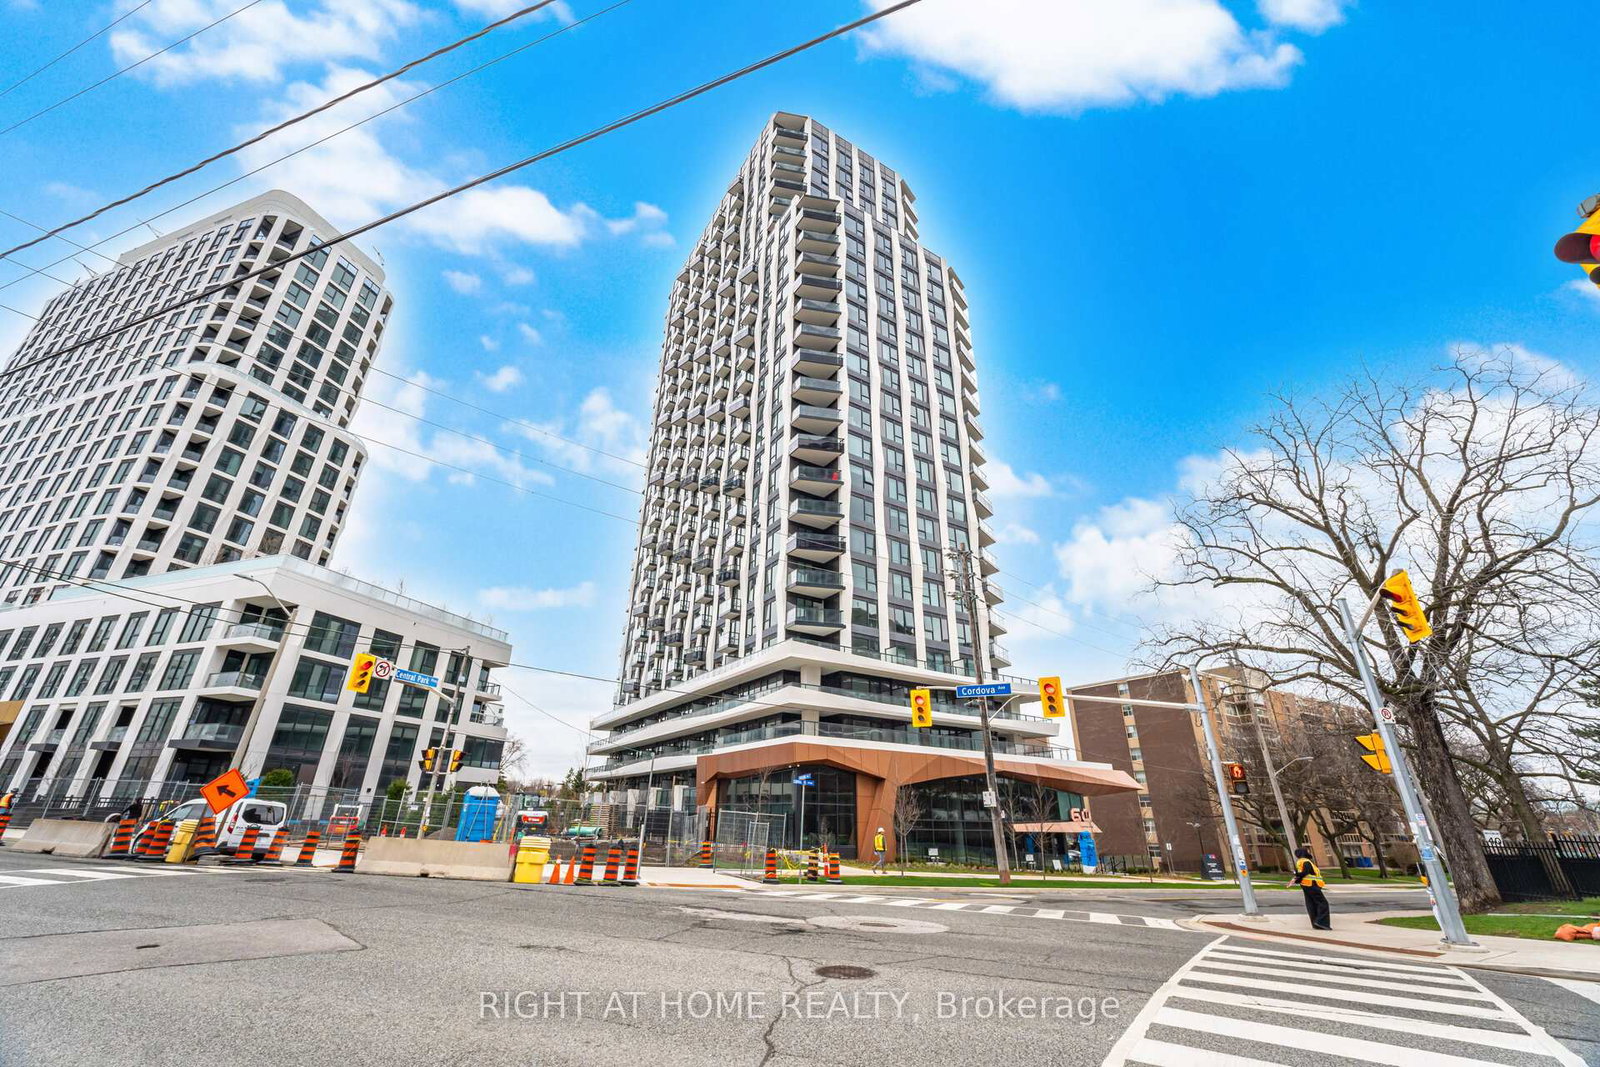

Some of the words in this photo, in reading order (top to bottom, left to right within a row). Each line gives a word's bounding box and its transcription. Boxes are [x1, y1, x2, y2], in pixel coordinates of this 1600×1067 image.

[397, 670, 416, 681] Central
[417, 675, 429, 684] Park
[961, 687, 996, 696] Cordova
[1071, 807, 1092, 822] 60
